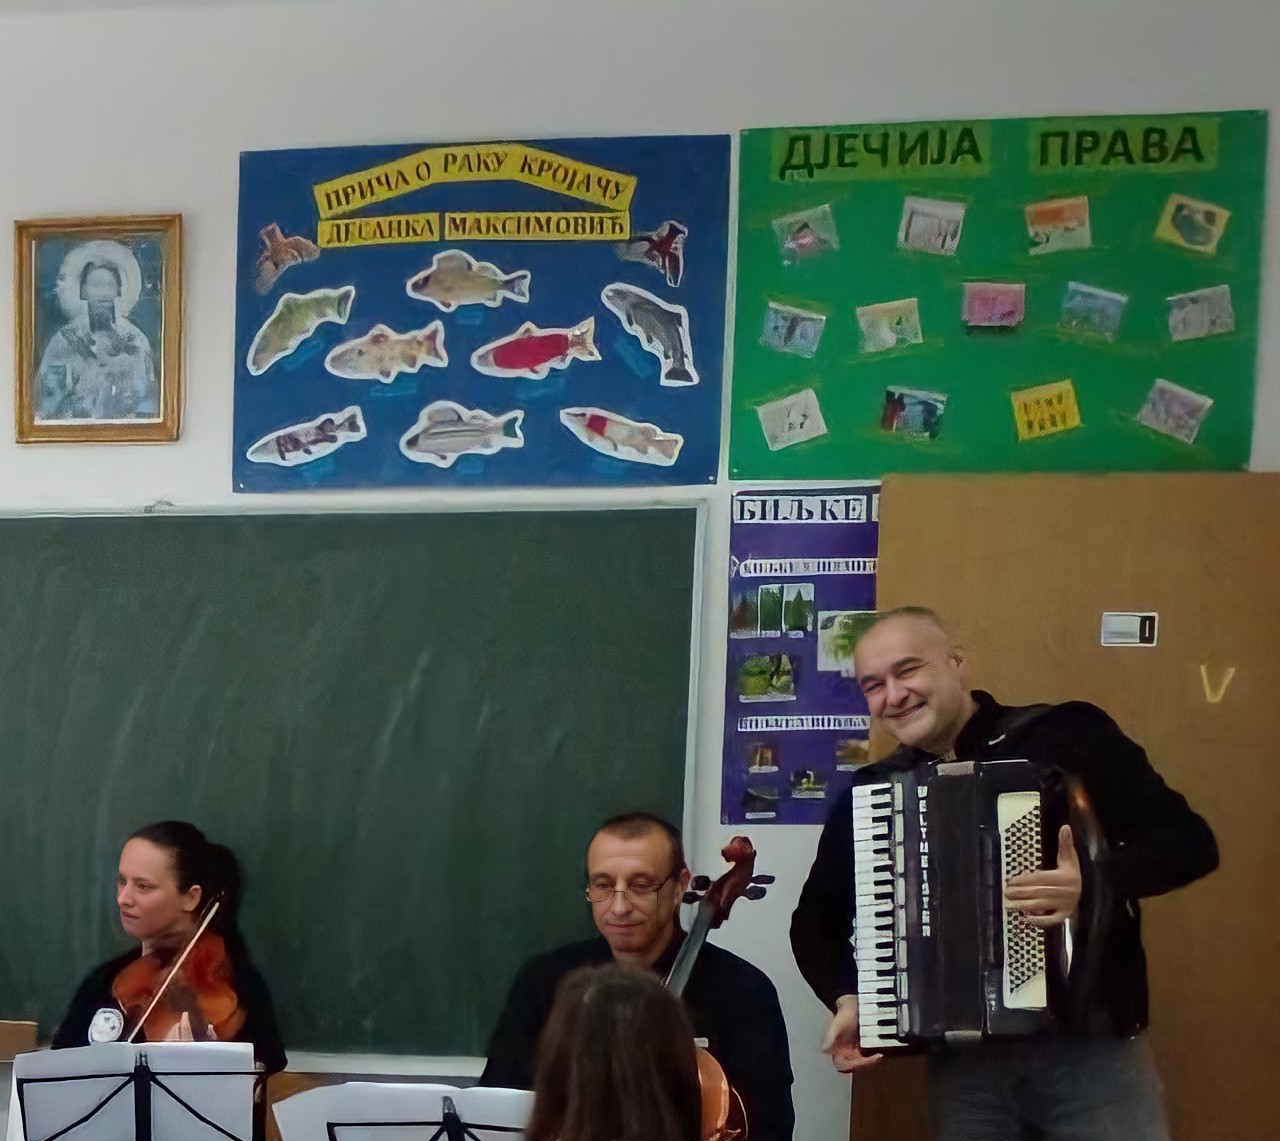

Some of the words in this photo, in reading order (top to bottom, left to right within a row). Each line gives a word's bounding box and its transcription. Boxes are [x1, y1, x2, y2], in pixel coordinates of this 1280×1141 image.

[779, 127, 983, 180] ДЈЕЧИЈА
[1038, 126, 1205, 167] ПРАВА
[325, 168, 410, 211] ПРИЧА
[415, 161, 432, 183] О
[444, 151, 510, 174] РАКУ
[520, 154, 629, 201] КРОЈАЧУ
[326, 217, 436, 244] ДЕСАНКА
[447, 214, 625, 237] МАКСИМОВИЋ
